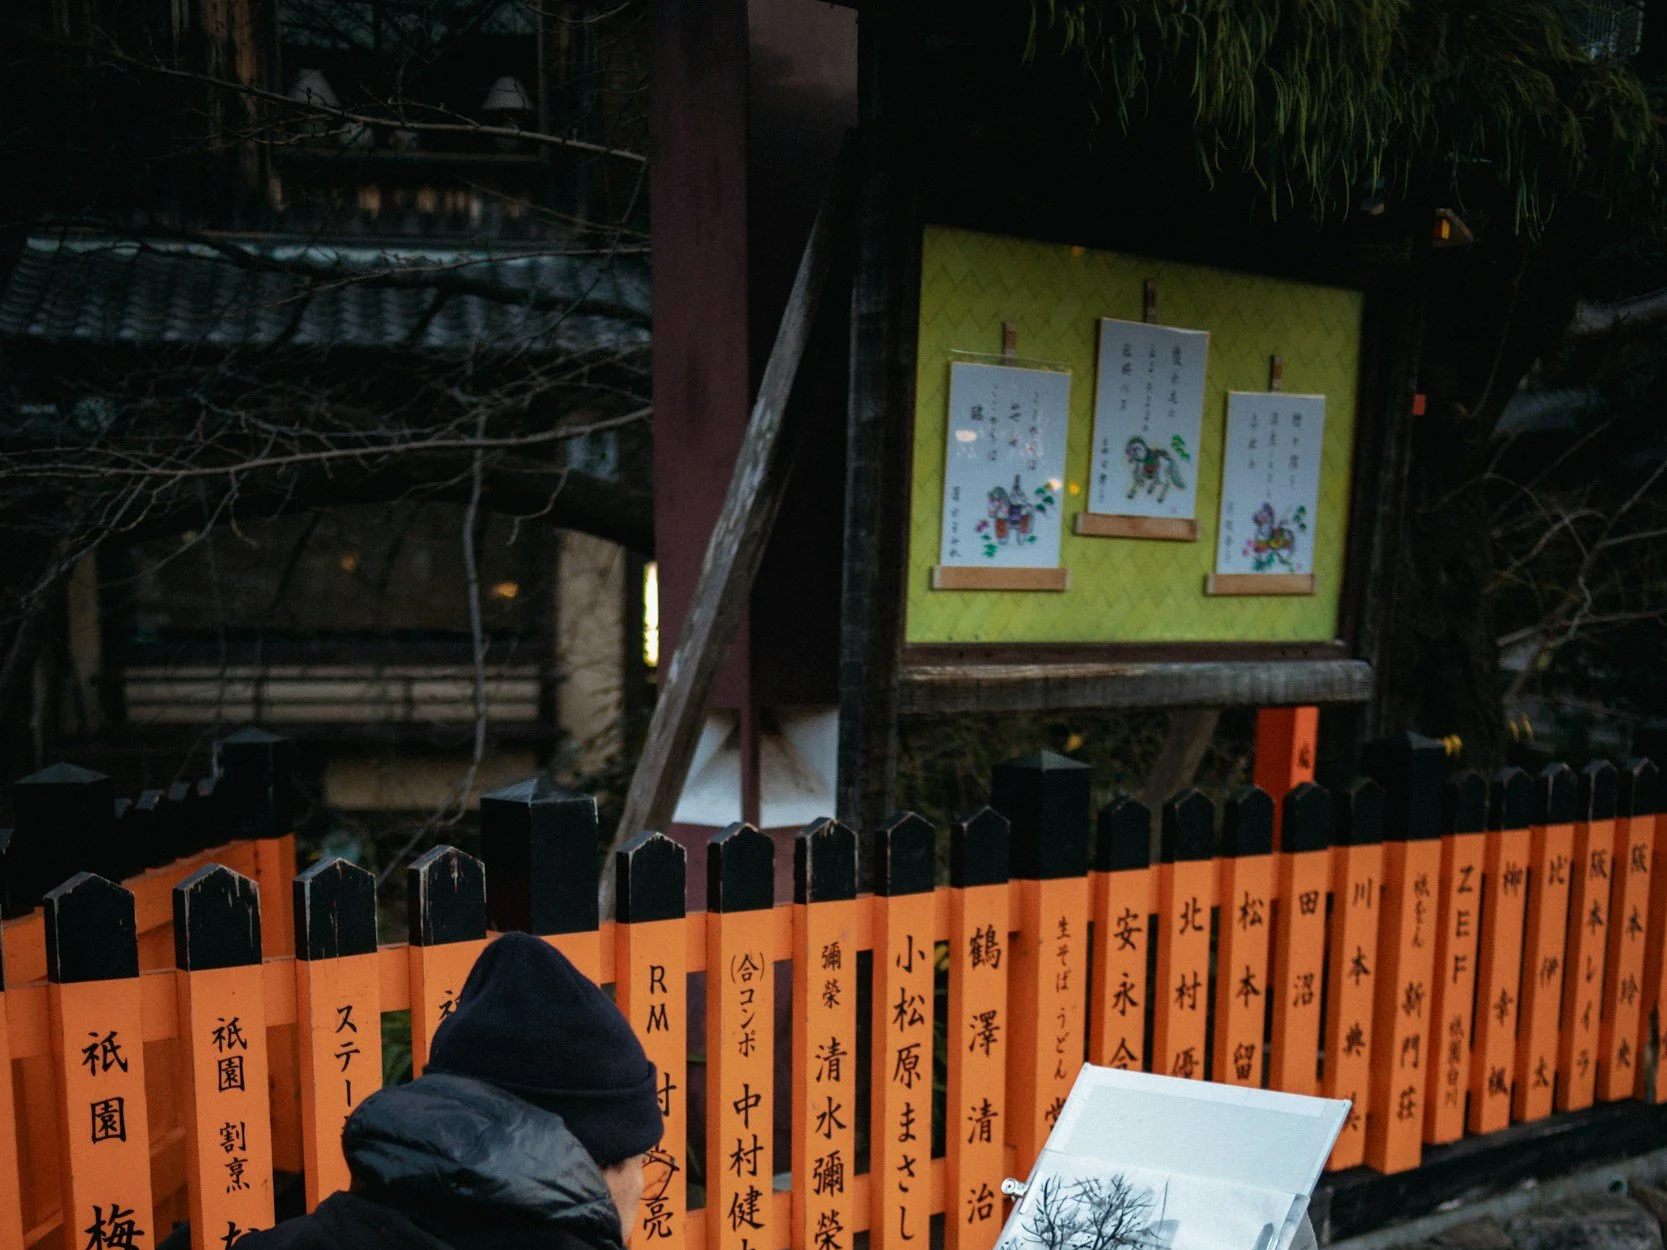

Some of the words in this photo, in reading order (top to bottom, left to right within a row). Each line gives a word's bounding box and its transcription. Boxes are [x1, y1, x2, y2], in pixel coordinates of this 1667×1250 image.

[1452, 865, 1475, 985] ZEF
[211, 1017, 249, 1092] 祇園
[646, 964, 670, 1034] RM
[82, 1032, 129, 1143] 祇園
[334, 1004, 361, 1136] ステー
[892, 934, 926, 1241] 小松原まさし
[967, 923, 1003, 1225] 鶴澤清治
[218, 1121, 251, 1194] 割烹
